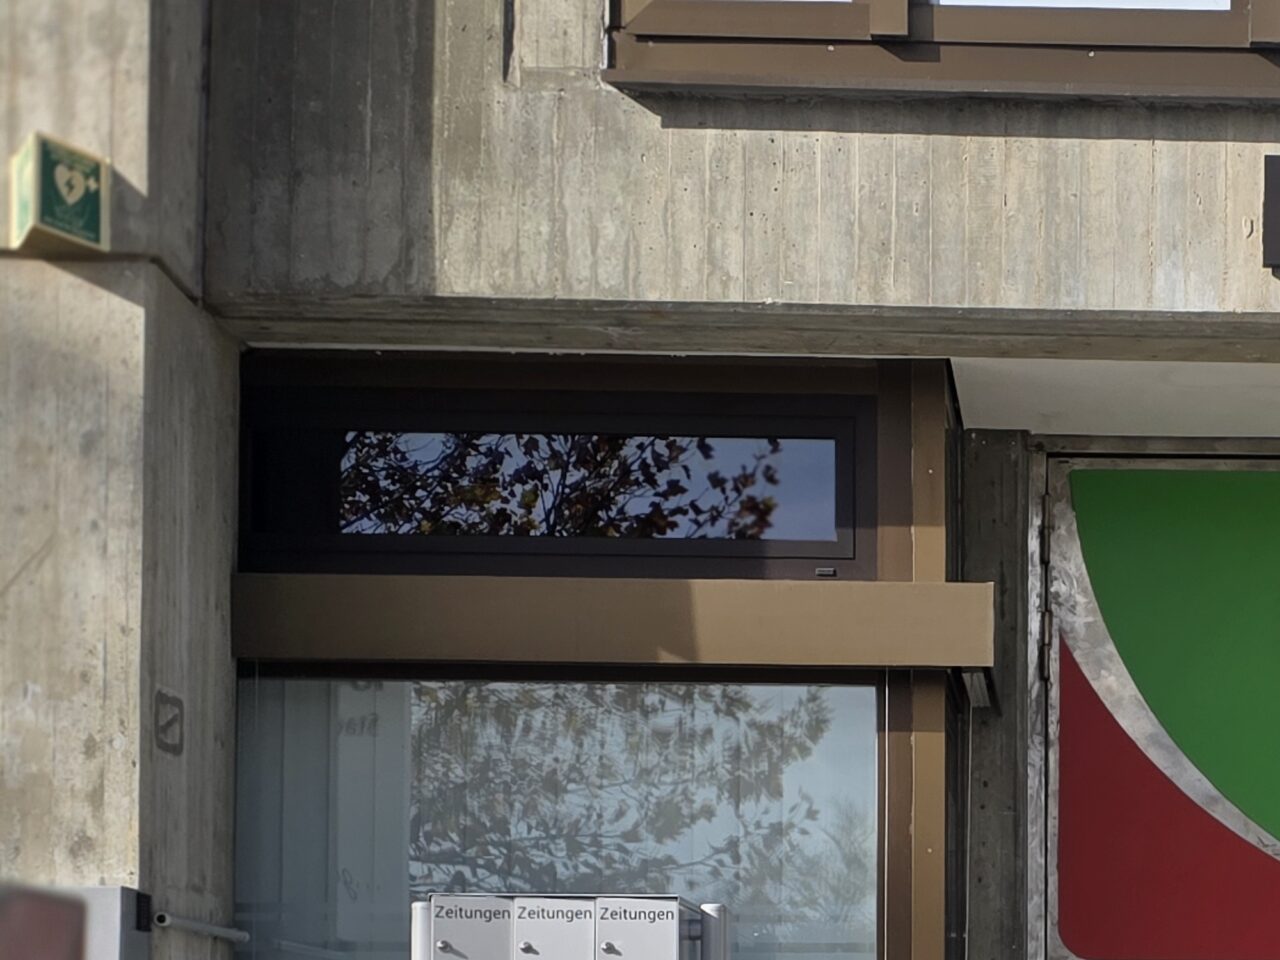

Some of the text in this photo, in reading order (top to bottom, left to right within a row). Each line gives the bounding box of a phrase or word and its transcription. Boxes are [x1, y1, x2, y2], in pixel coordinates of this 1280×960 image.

[434, 905, 511, 922] Zeitungen
[517, 906, 593, 922] Zeitungen
[599, 907, 675, 923] Zeitungen
